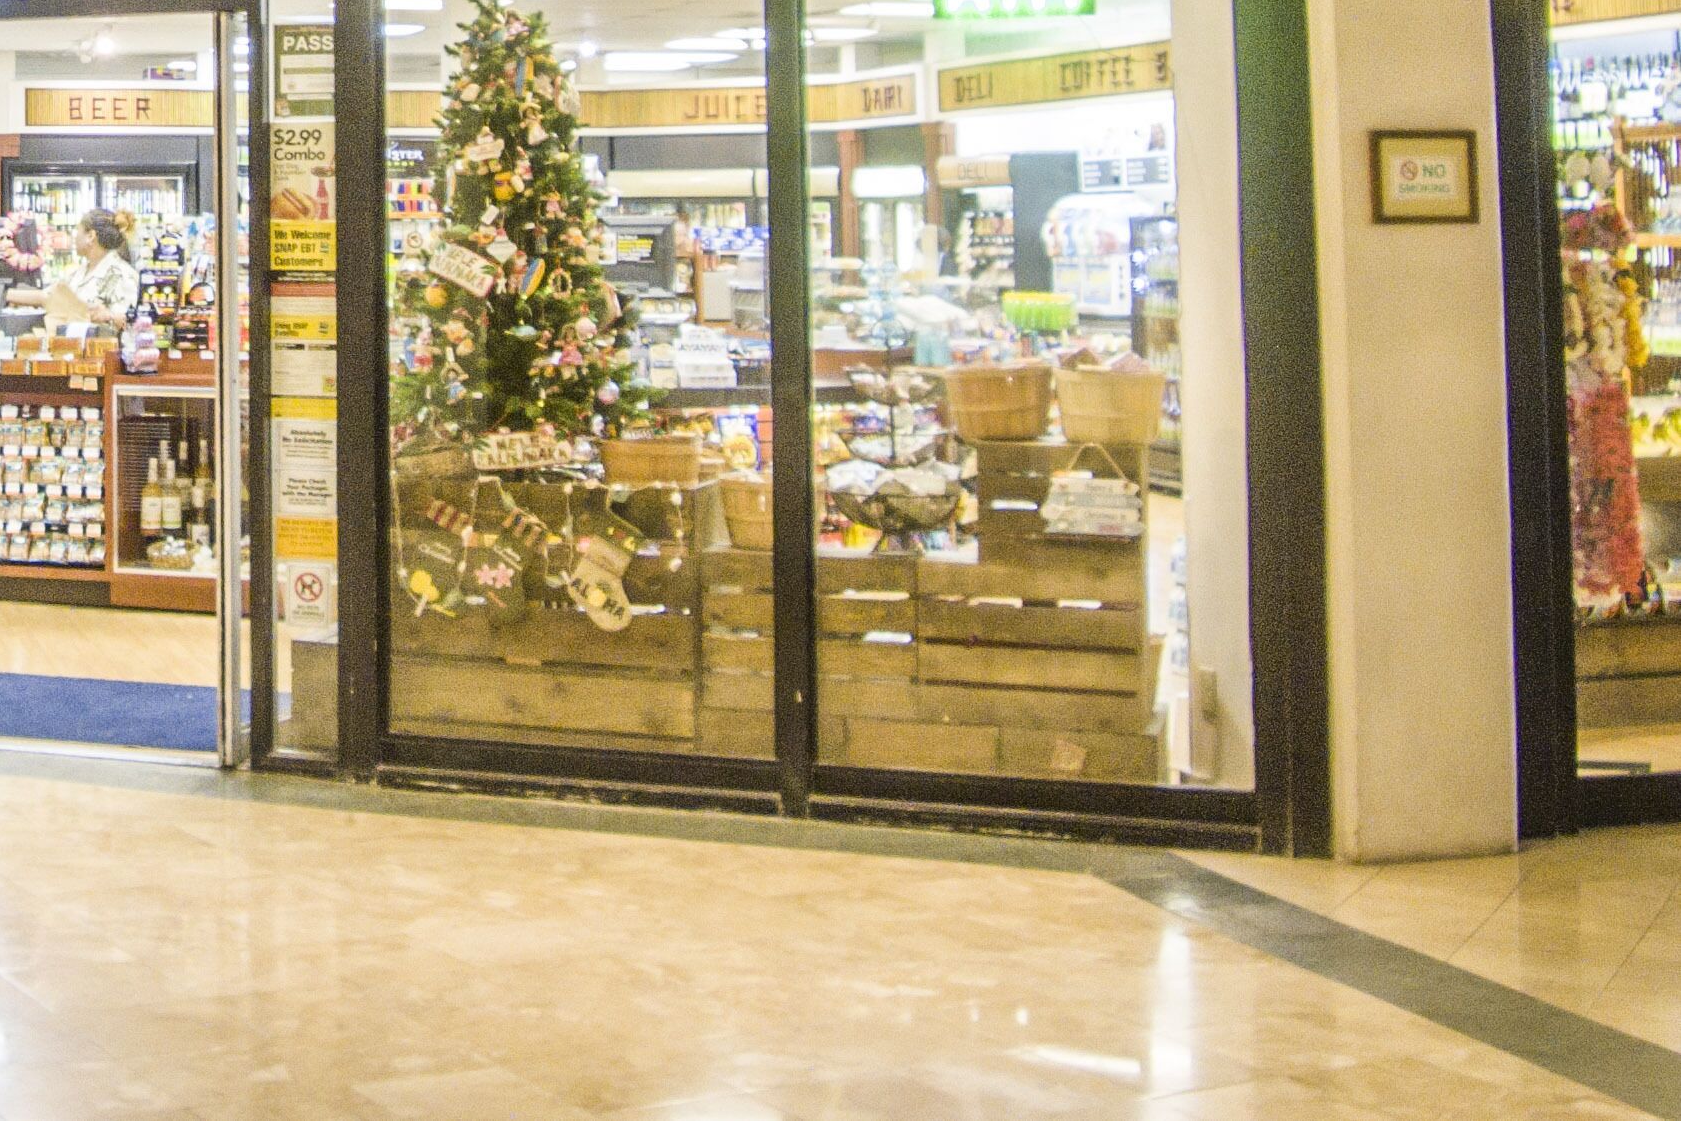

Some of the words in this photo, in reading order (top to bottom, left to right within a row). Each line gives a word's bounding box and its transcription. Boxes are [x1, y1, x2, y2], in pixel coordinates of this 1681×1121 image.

[69, 96, 151, 120] BEER
[273, 128, 323, 147] $2.99
[273, 145, 326, 161] Combo
[1422, 164, 1447, 179] NO
[274, 229, 288, 240] We
[291, 229, 332, 240] Welcome
[274, 242, 298, 253] SNAP
[274, 257, 324, 268] Customers
